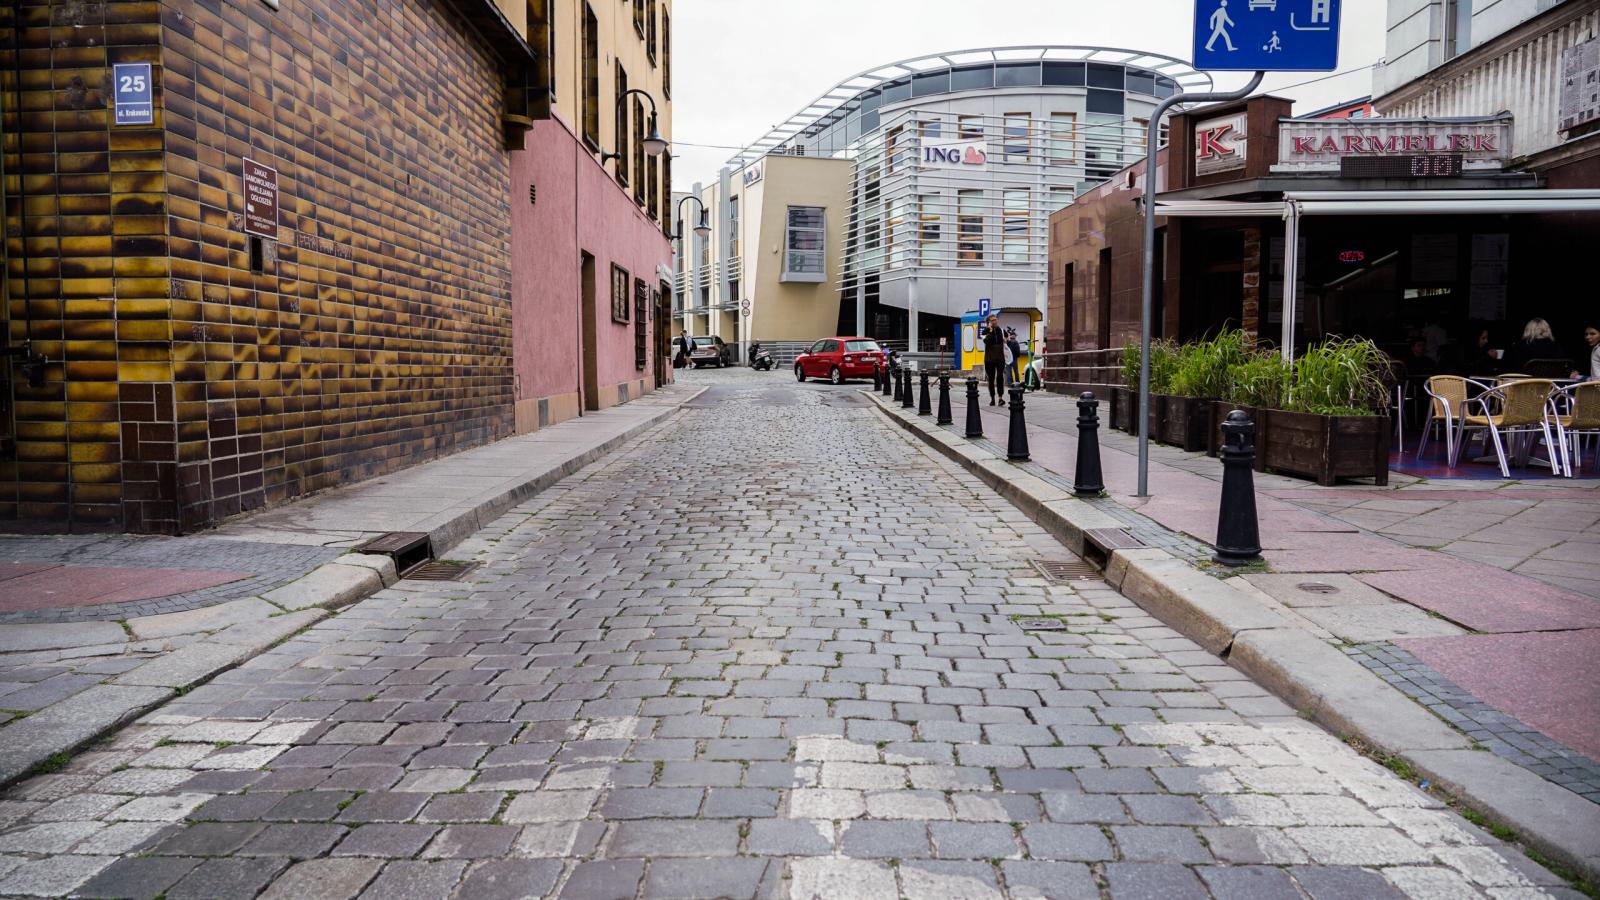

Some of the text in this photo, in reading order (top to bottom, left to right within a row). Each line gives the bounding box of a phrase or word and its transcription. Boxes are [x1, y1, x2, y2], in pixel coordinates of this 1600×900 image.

[120, 75, 145, 92] 25
[1196, 124, 1236, 159] K
[1292, 133, 1500, 154] KARMELEK
[924, 146, 961, 164] ING
[254, 168, 268, 179] ZAKAZ
[245, 174, 277, 190] SAMOWOLNEGO
[248, 183, 274, 198] NAKLEJANIA
[251, 193, 272, 206] OGŁOSZEŃ
[981, 300, 989, 316] P
